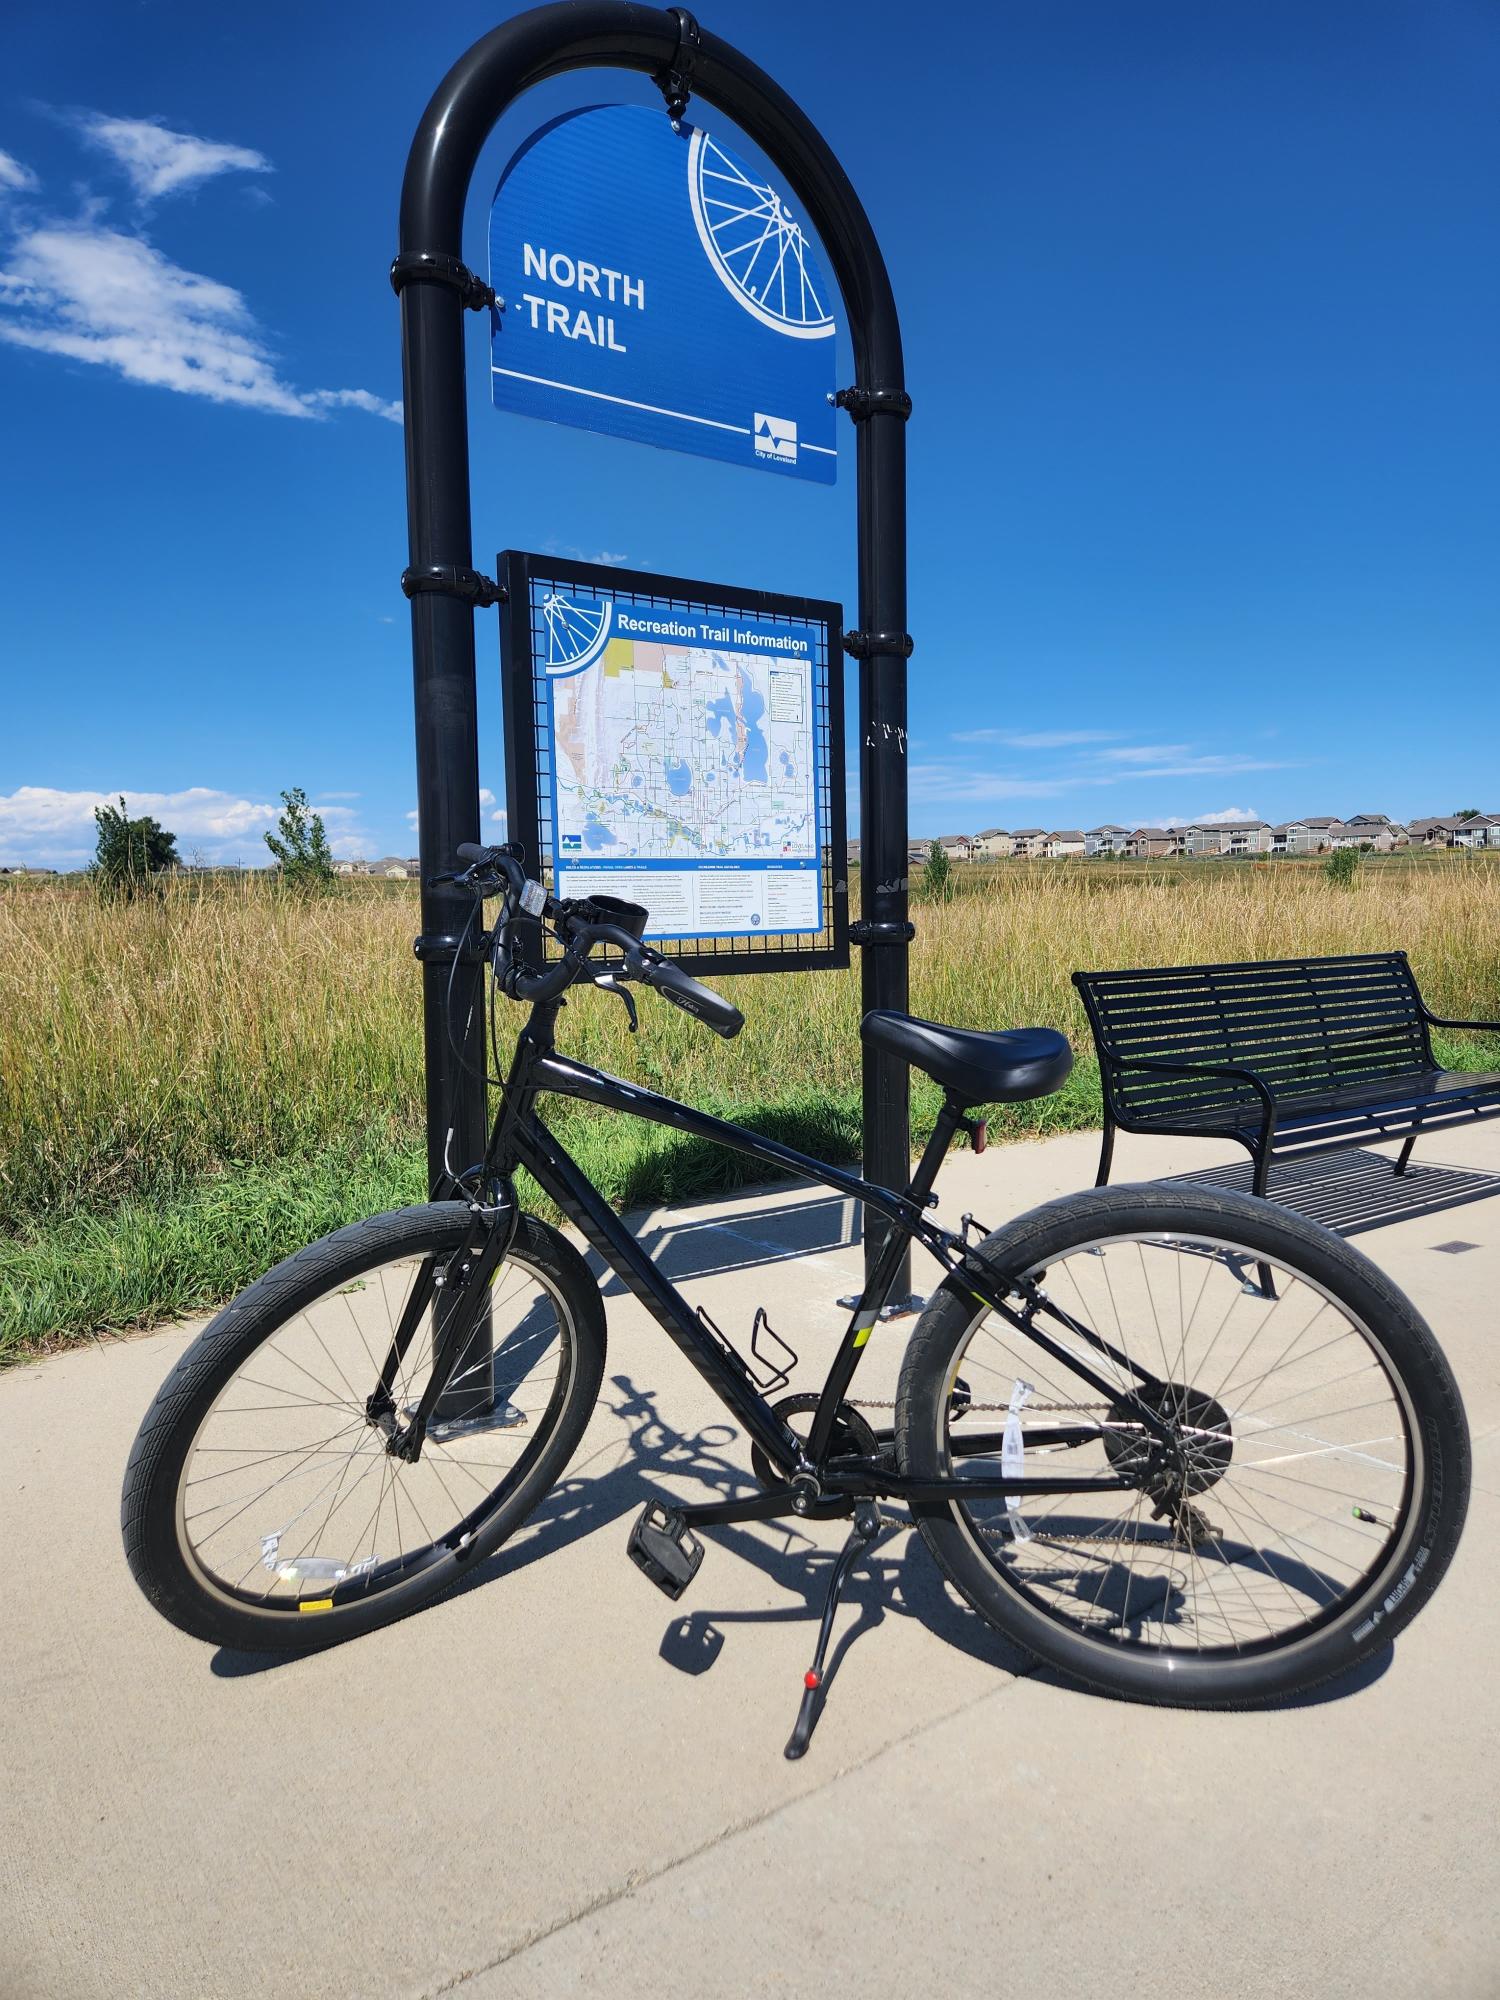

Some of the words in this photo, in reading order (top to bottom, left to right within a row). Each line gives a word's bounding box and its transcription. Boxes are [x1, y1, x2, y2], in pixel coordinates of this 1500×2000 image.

[523, 242, 645, 311] NORTH
[522, 293, 627, 353] TRAIL
[617, 613, 697, 638] Recreation
[700, 624, 730, 643] Trail
[734, 630, 807, 652] Information
